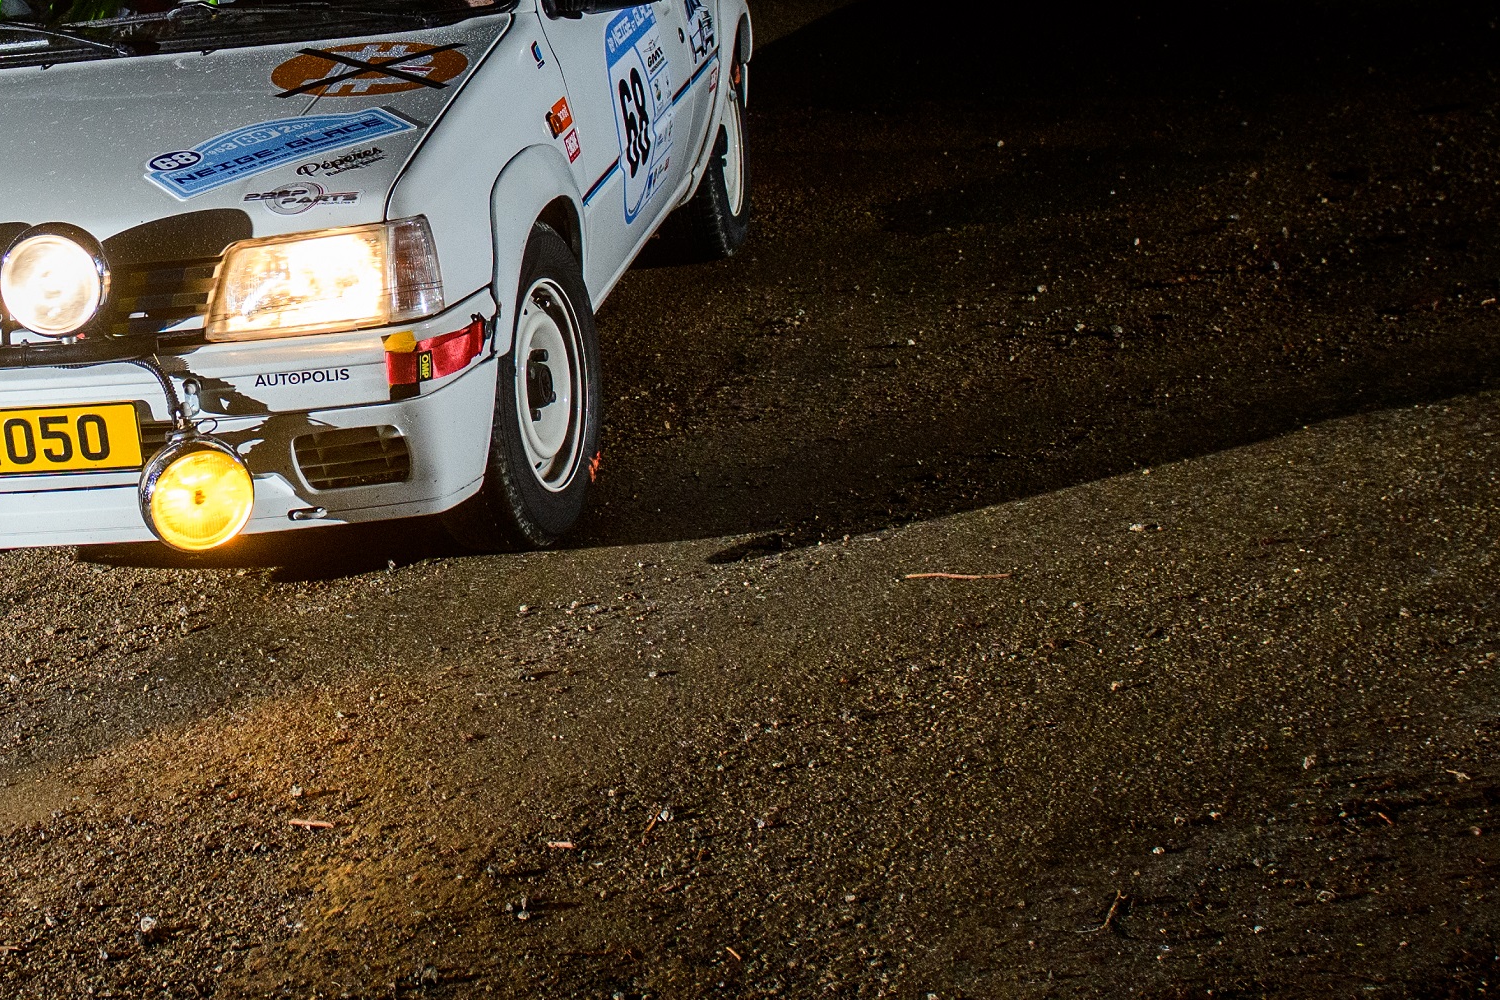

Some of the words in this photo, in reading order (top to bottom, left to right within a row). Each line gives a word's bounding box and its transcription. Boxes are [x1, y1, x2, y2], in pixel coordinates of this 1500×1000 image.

[647, 46, 664, 68] GMT
[619, 67, 650, 179] 68
[152, 152, 199, 170] 68
[174, 149, 274, 184] NEIGE
[285, 119, 385, 149] GLACE
[281, 192, 359, 205] PARTS
[420, 354, 430, 379] OMP
[255, 368, 350, 388] AUTOPOLIS
